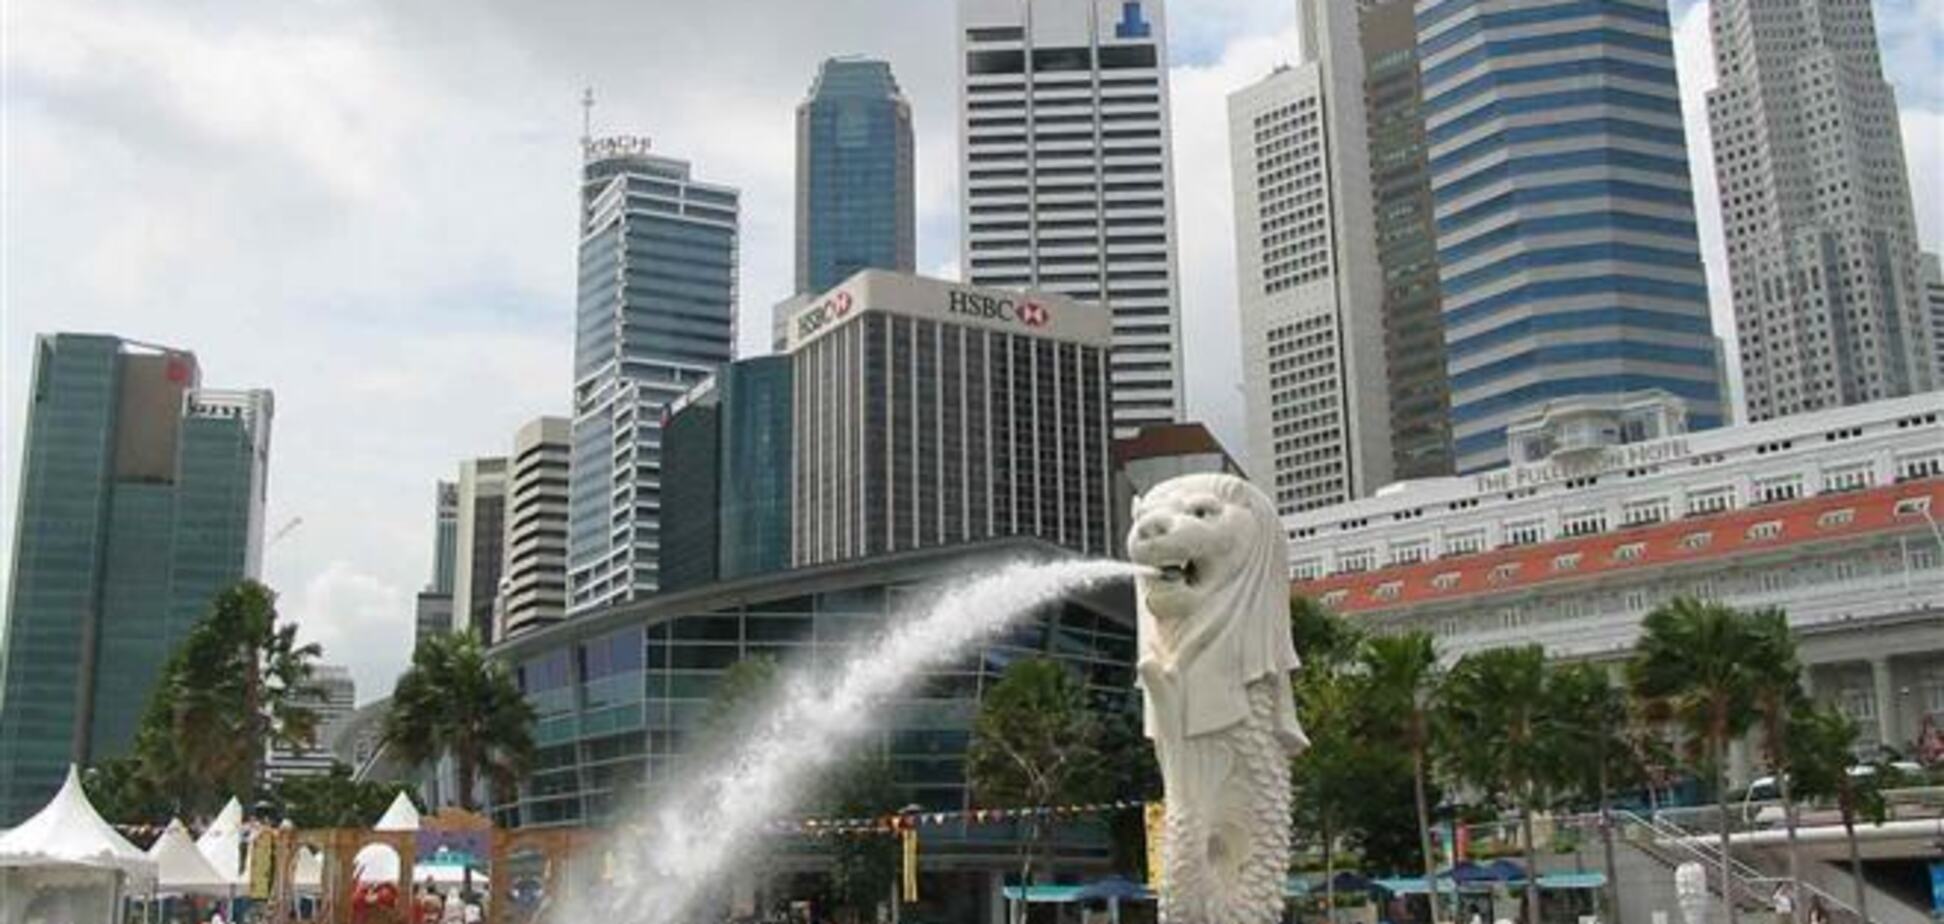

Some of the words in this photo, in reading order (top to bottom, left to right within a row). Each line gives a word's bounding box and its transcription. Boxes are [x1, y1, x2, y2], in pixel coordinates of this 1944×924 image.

[584, 135, 652, 155] TACHI
[799, 300, 834, 339] HSBC
[949, 291, 1014, 321] HSBC
[1477, 473, 1509, 493] THE
[1517, 451, 1624, 483] FULLN
[1629, 438, 1693, 462] HOTEL
